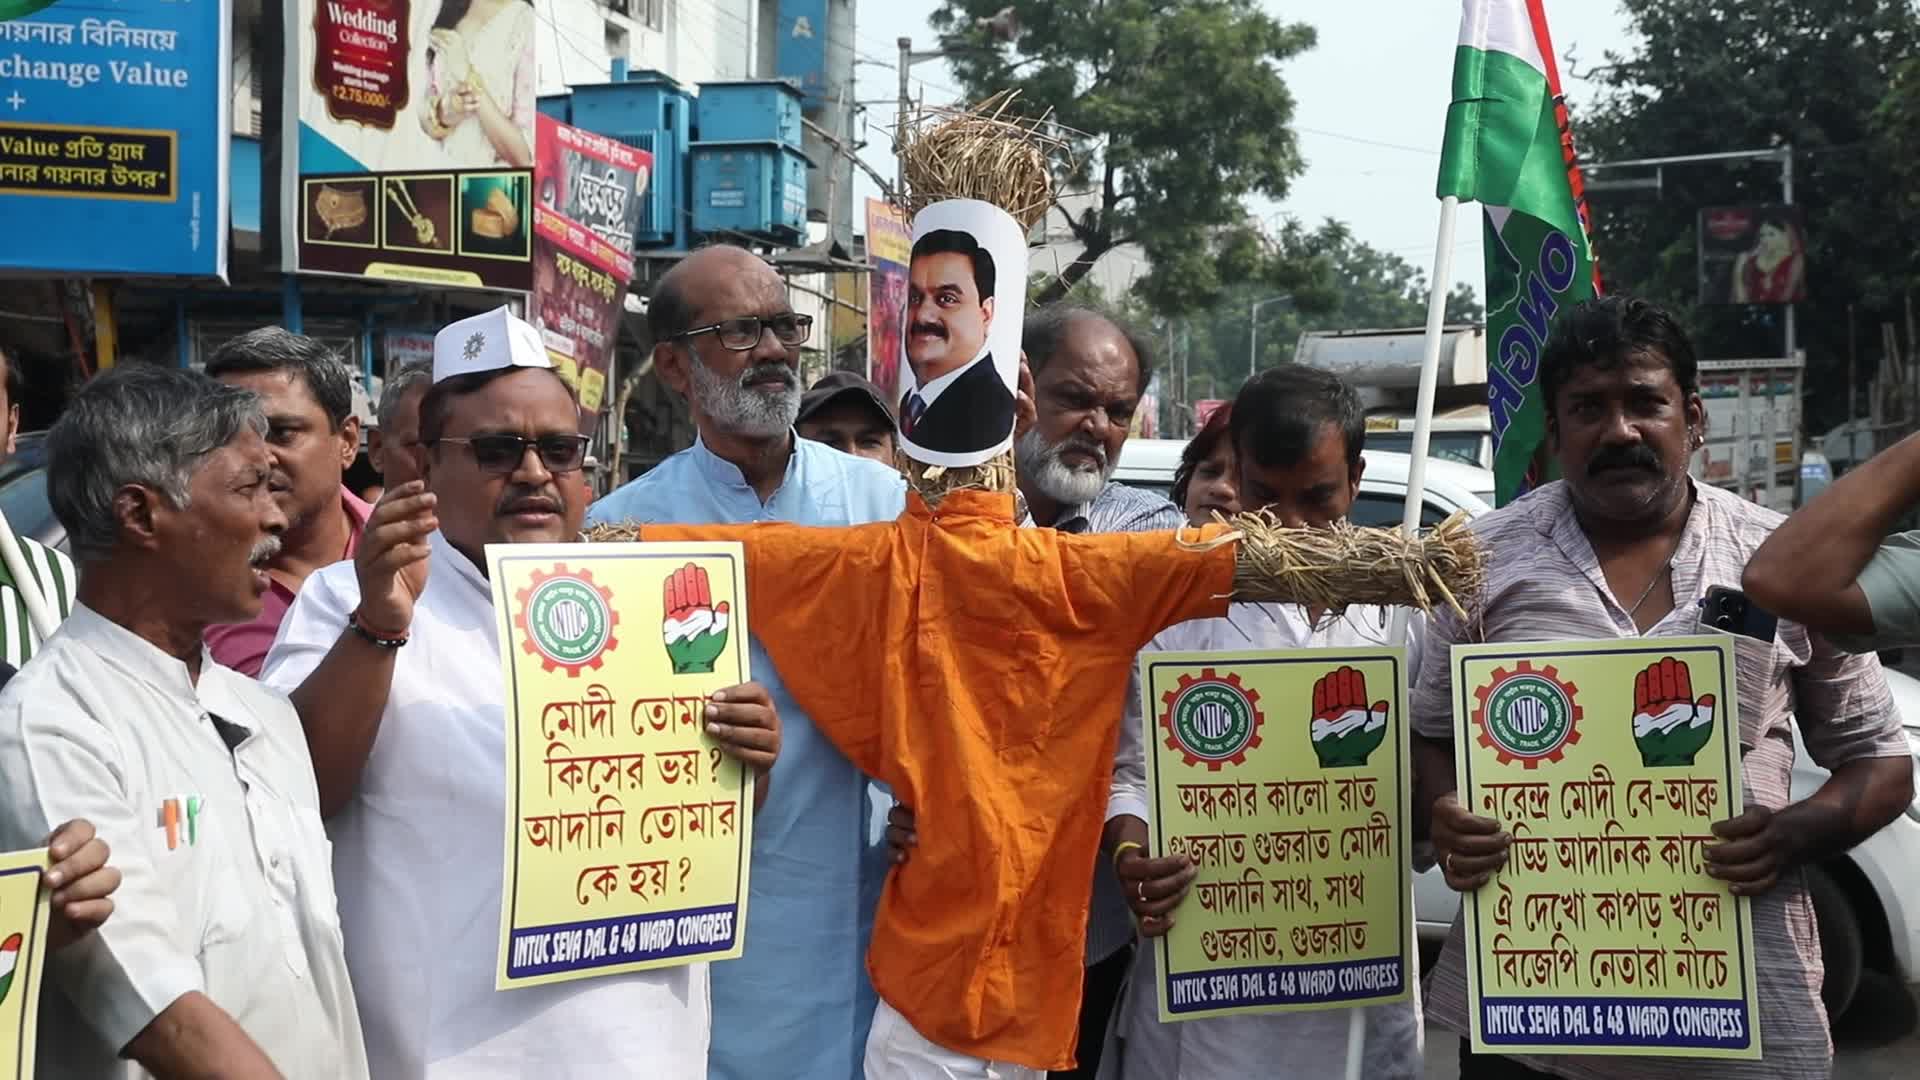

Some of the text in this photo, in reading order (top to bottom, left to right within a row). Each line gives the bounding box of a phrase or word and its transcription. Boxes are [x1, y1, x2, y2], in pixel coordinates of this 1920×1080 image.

[80, 18, 178, 51] বিনিময়ে
[327, 2, 397, 44] Wedding
[339, 30, 388, 52] Collection
[109, 61, 188, 88] Value
[0, 136, 146, 162] Value প্রতি গ্রাম
[43, 166, 105, 186] গয়নার
[542, 684, 715, 741] মোদী তোমা
[1195, 704, 1230, 737] INTUC
[1510, 697, 1547, 732] INTUC
[544, 742, 645, 798] কিসের
[656, 749, 700, 784] ভয়
[1480, 764, 1718, 822] নরেন্দ্র মোদী বে-আব্রু
[1178, 774, 1378, 822] অন্ধকার কালো রাত
[524, 794, 736, 853] আদানি তোমার
[1252, 826, 1332, 865] গুজরাত
[1340, 811, 1391, 860] মোদী
[1554, 820, 1650, 876] আদানিক
[576, 864, 620, 906] কে
[628, 859, 669, 902] হয়
[1196, 868, 1364, 916] আদানি সাথ, সাথ
[1494, 875, 1722, 943] ঐ দেখো কাপড় খুলে
[514, 912, 732, 968] INTUC SEVA DAL & 48 WARD CONGRESS
[1200, 920, 1368, 962] গুজরাত, গুজরাত
[1492, 932, 1728, 990] বিজেপি নেতারা নাচে
[1172, 963, 1399, 1005] INTUC SEVA DAL & 48 WARD CONGRESS
[1486, 1005, 1743, 1040] INTUC SEVA DAL & 48 WARD CONGRESS
